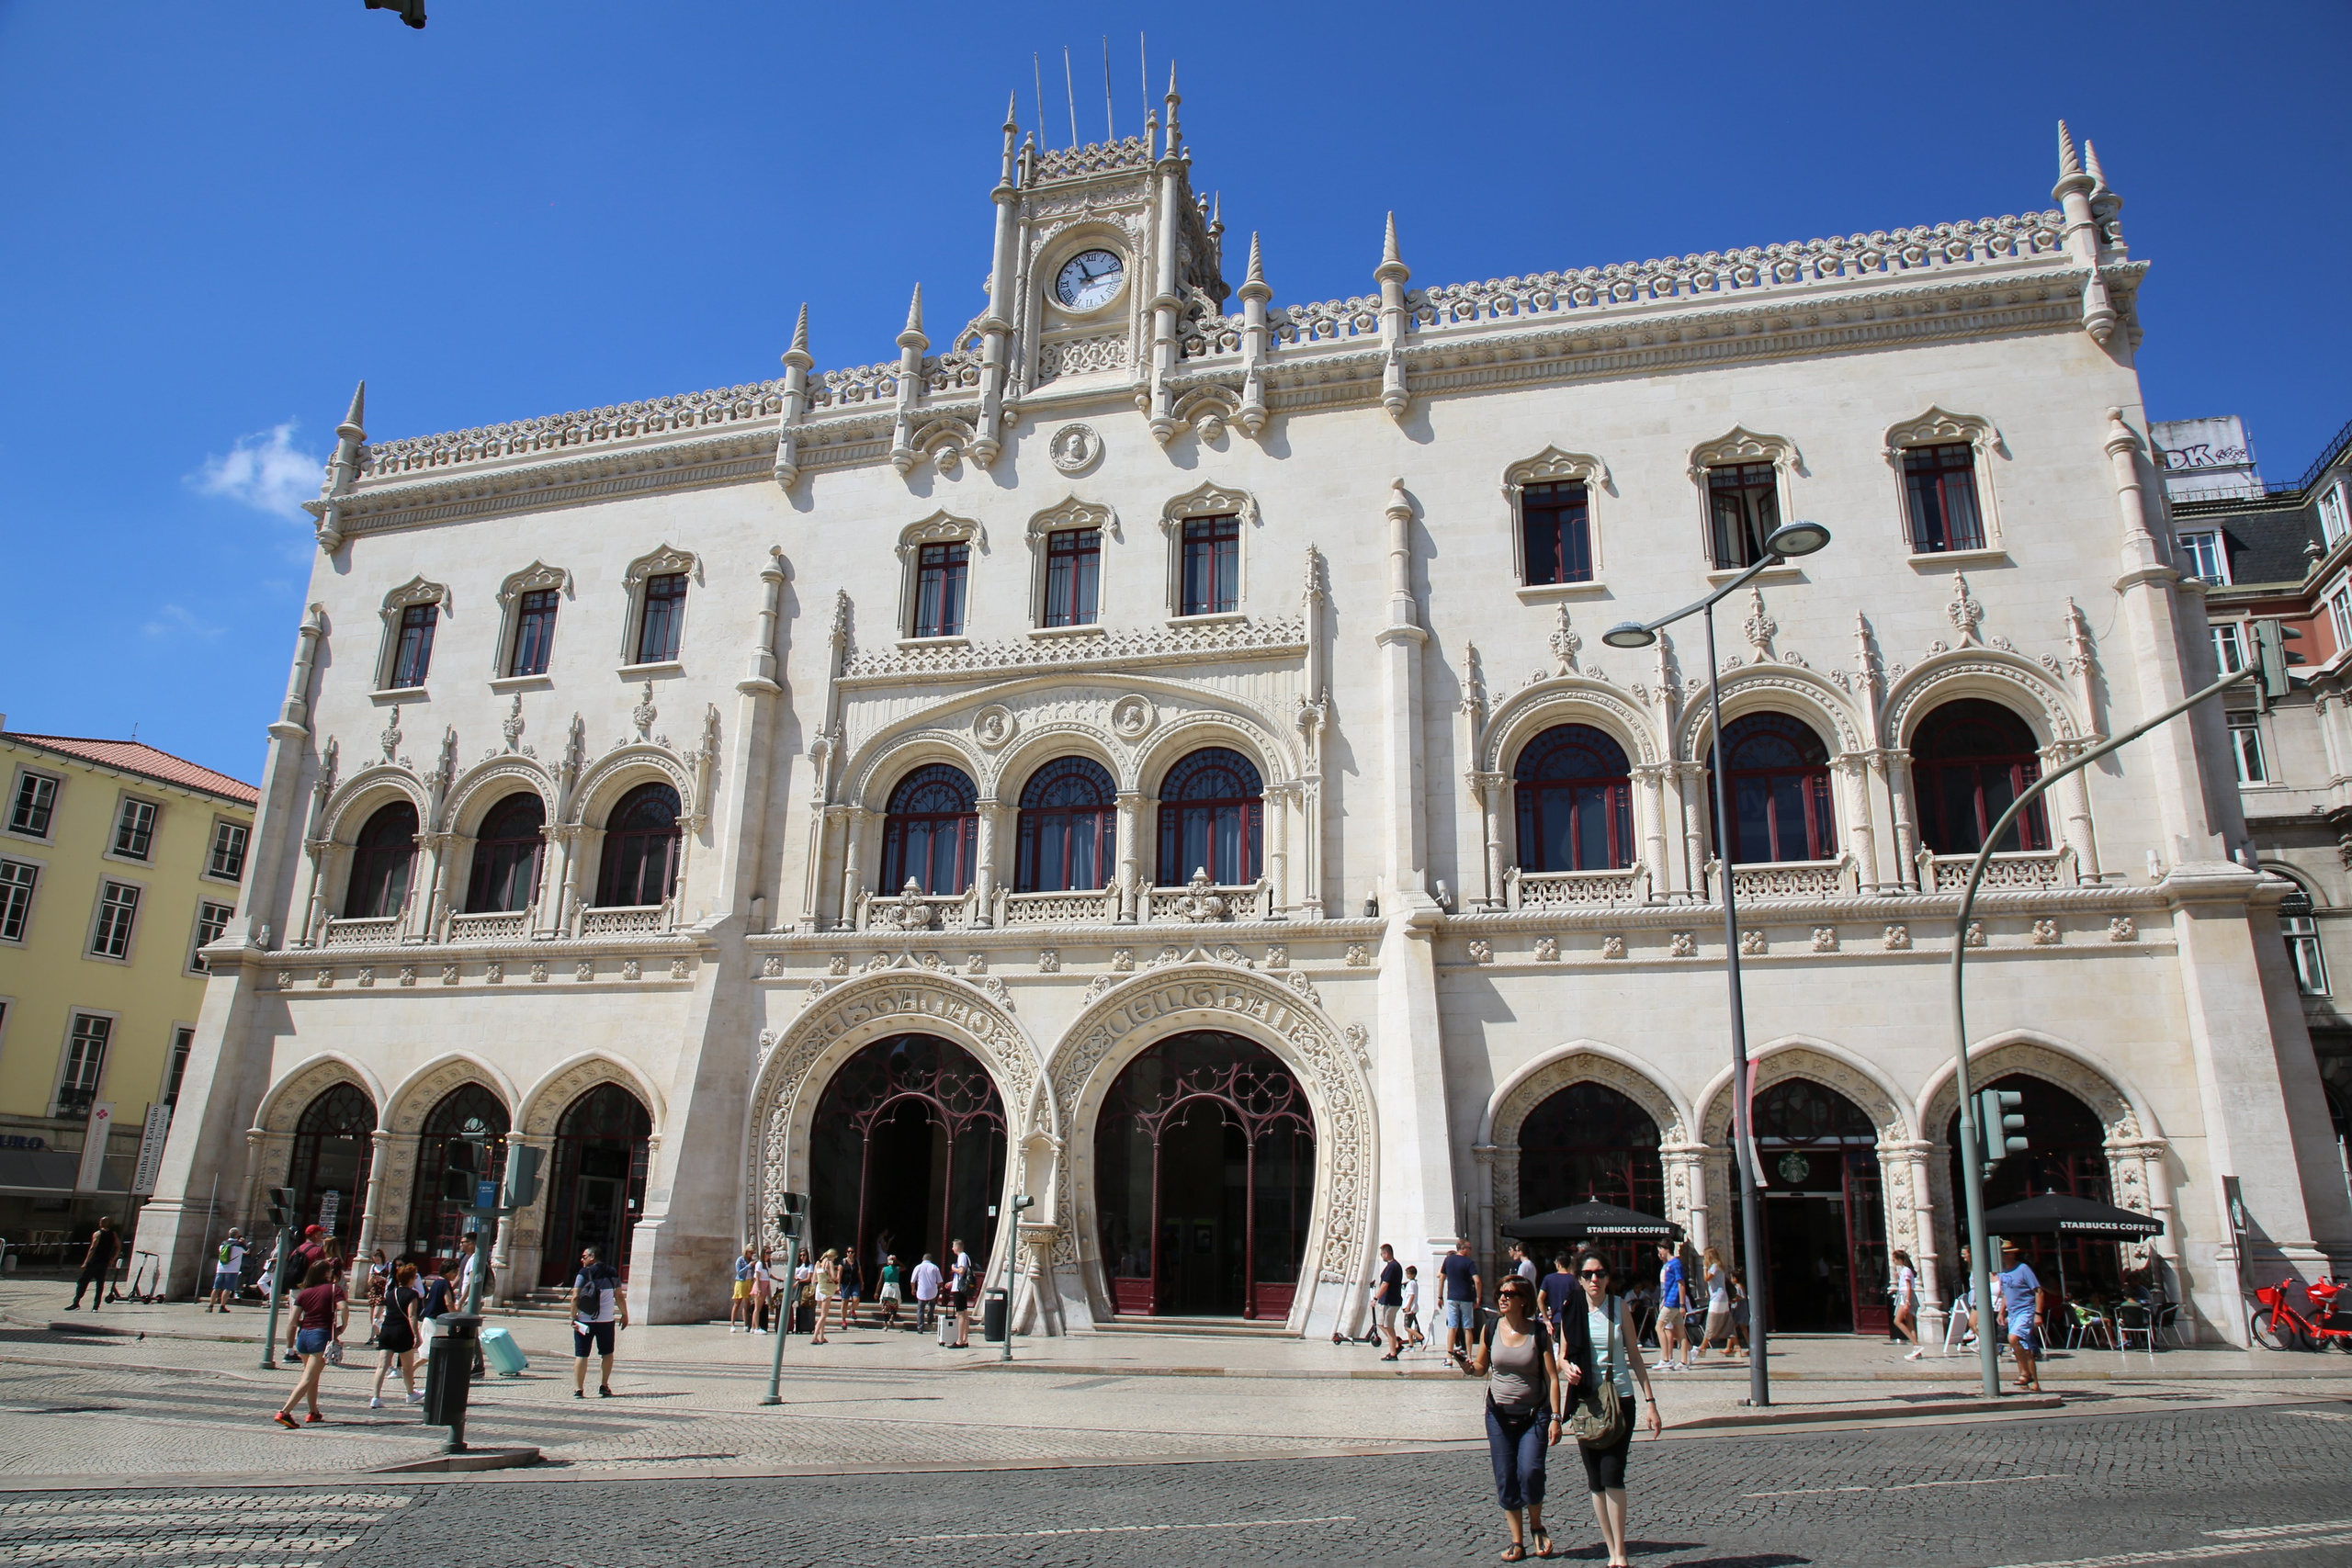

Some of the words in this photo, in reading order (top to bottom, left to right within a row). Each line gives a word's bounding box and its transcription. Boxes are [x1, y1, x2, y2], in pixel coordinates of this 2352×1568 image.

[146, 1107, 159, 1140] Estação
[143, 1143, 153, 1153] da
[146, 1147, 160, 1186] Restaurant
[155, 1113, 166, 1139] Terrace
[135, 1154, 150, 1190] Cozinha
[2060, 1221, 2118, 1230] STARBUCKS
[2120, 1223, 2157, 1233] COFFEE
